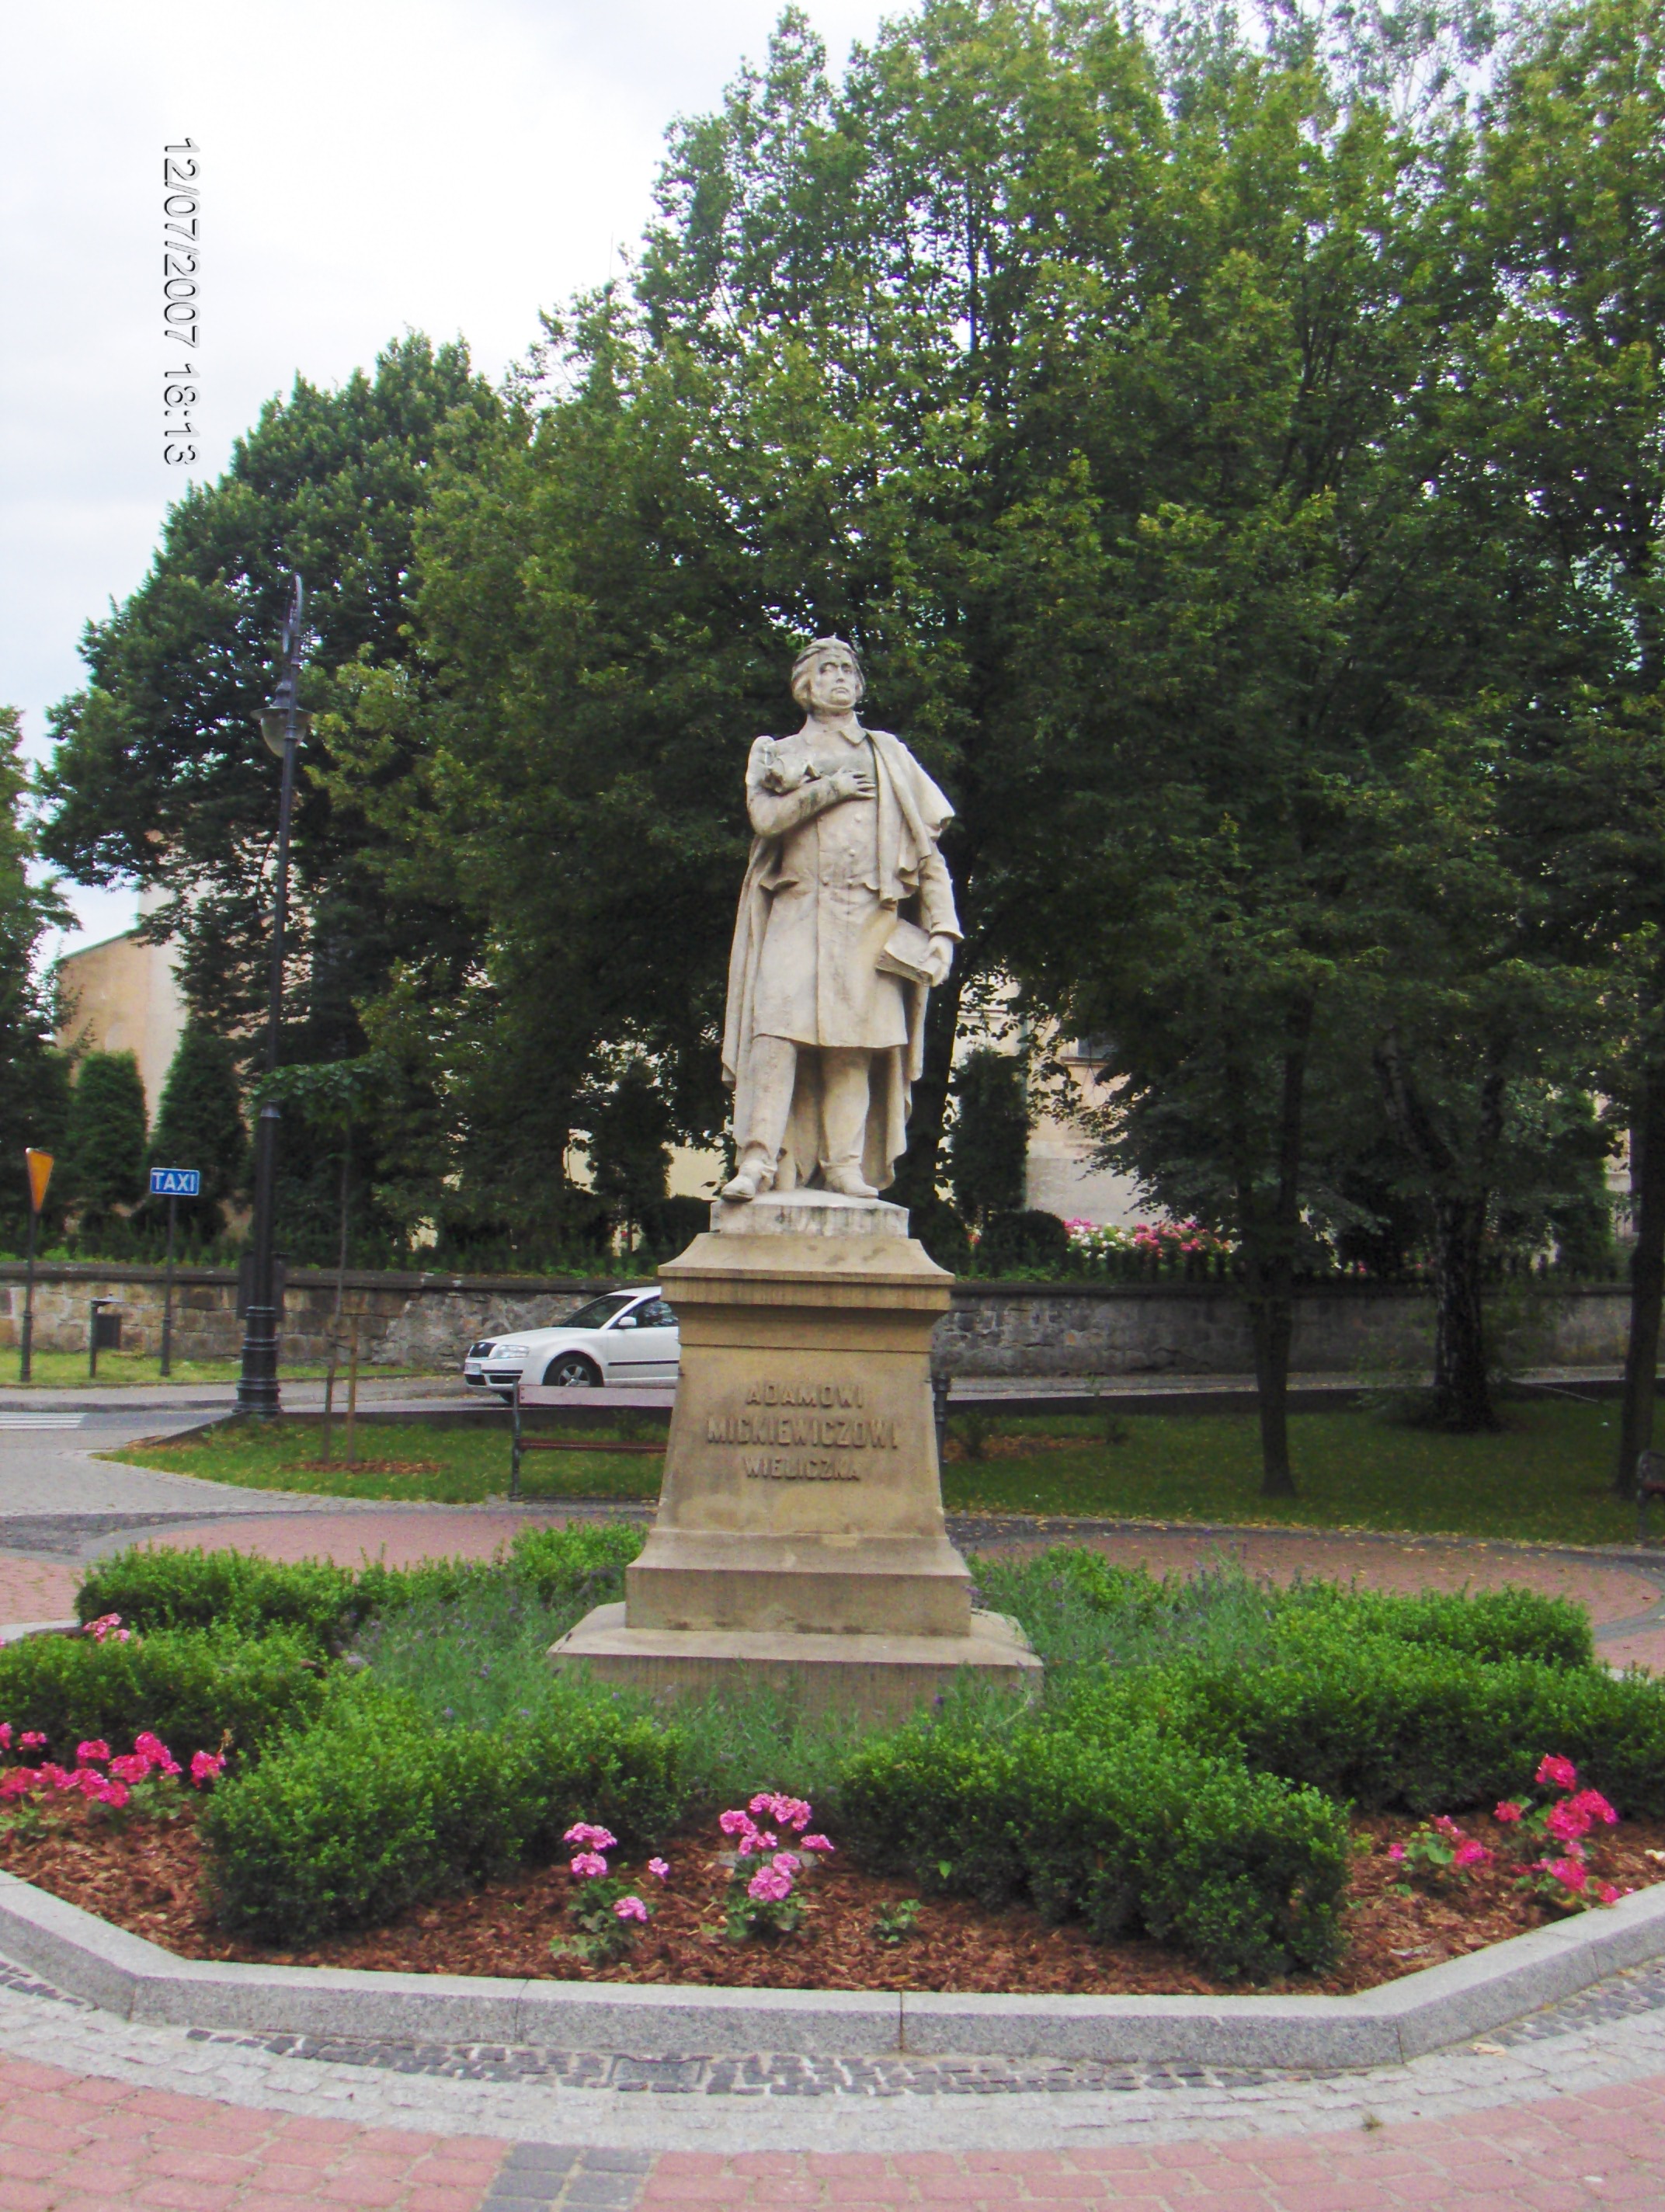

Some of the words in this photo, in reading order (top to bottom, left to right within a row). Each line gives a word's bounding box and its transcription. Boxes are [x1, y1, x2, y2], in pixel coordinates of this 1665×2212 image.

[151, 1171, 194, 1192] TAXI
[745, 1384, 863, 1408] ADAMOWI
[707, 1416, 898, 1449] MICKIEWICZOWI
[743, 1457, 860, 1481] WIELICZKA
